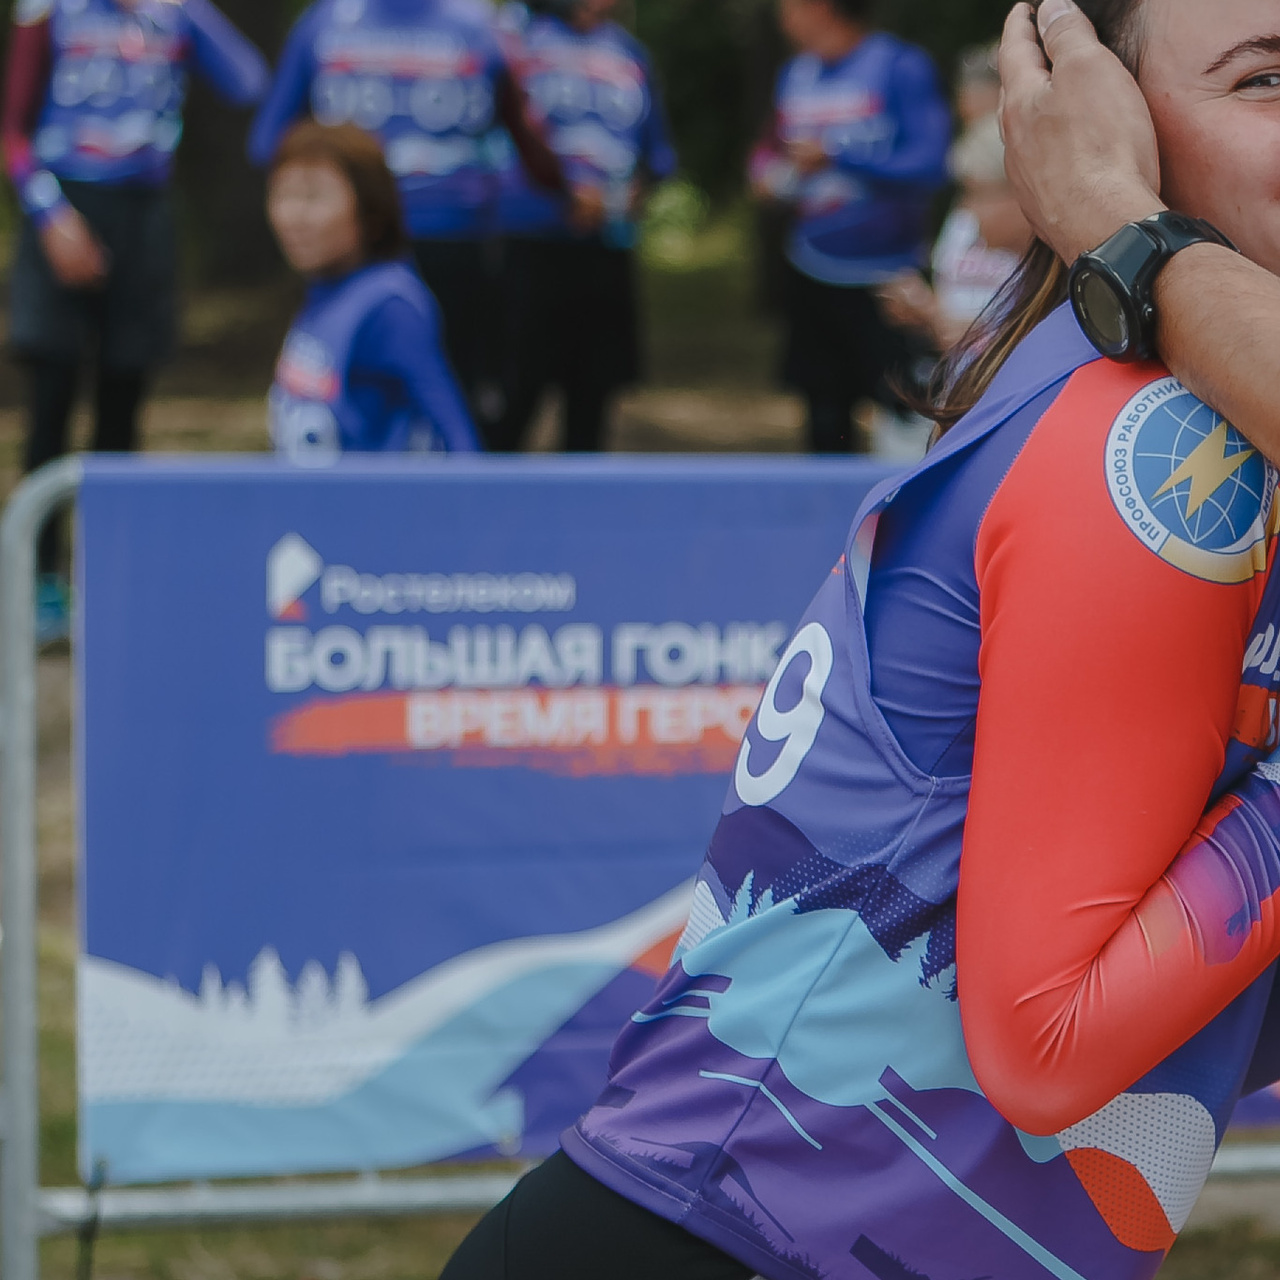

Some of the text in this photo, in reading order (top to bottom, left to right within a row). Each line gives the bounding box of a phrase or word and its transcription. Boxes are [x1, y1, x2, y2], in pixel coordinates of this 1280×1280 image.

[1117, 381, 1184, 443] РАБОТНИ
[1113, 447, 1161, 542] ПРОФСОЮЗ
[325, 567, 573, 611] Ростелеком
[267, 622, 788, 691] БОЛЬШАЯ ГОНК
[405, 690, 758, 749] ВРЕМЯ ГЕРО
[735, 622, 834, 806] 9
